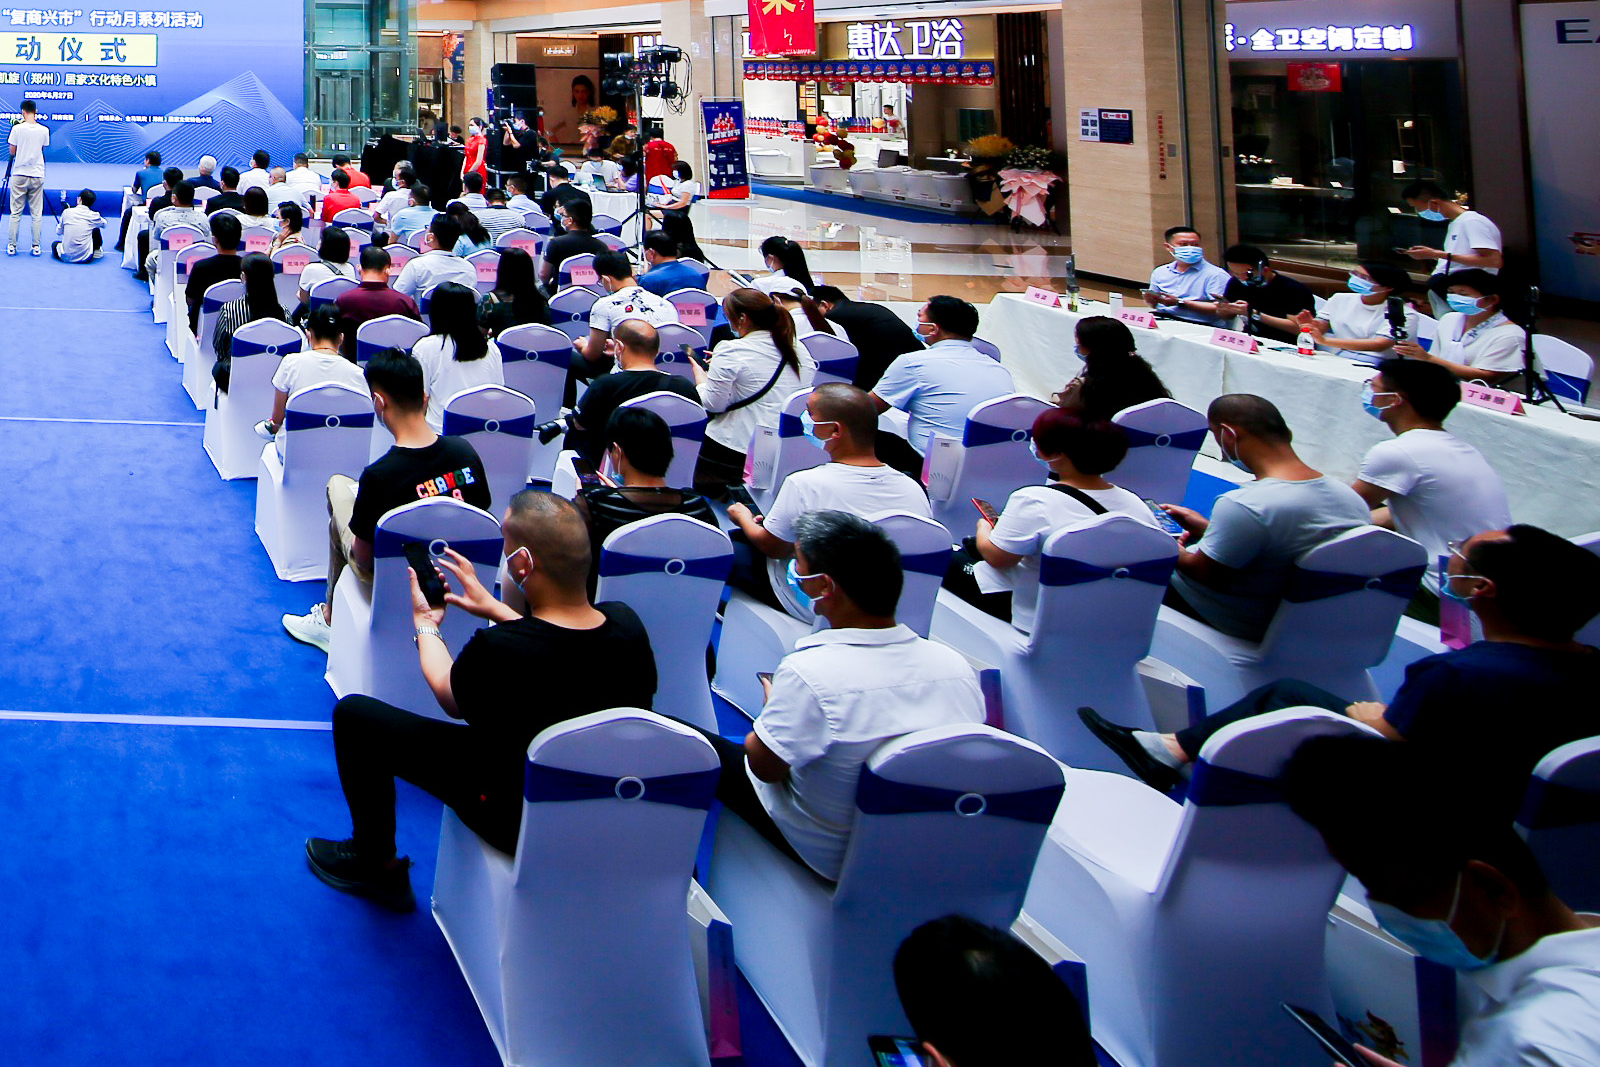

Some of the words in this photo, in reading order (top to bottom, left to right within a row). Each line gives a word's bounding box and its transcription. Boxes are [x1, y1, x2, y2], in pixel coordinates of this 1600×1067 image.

[847, 18, 963, 61] 惠达卫浴
[416, 466, 475, 499] CHANGE
